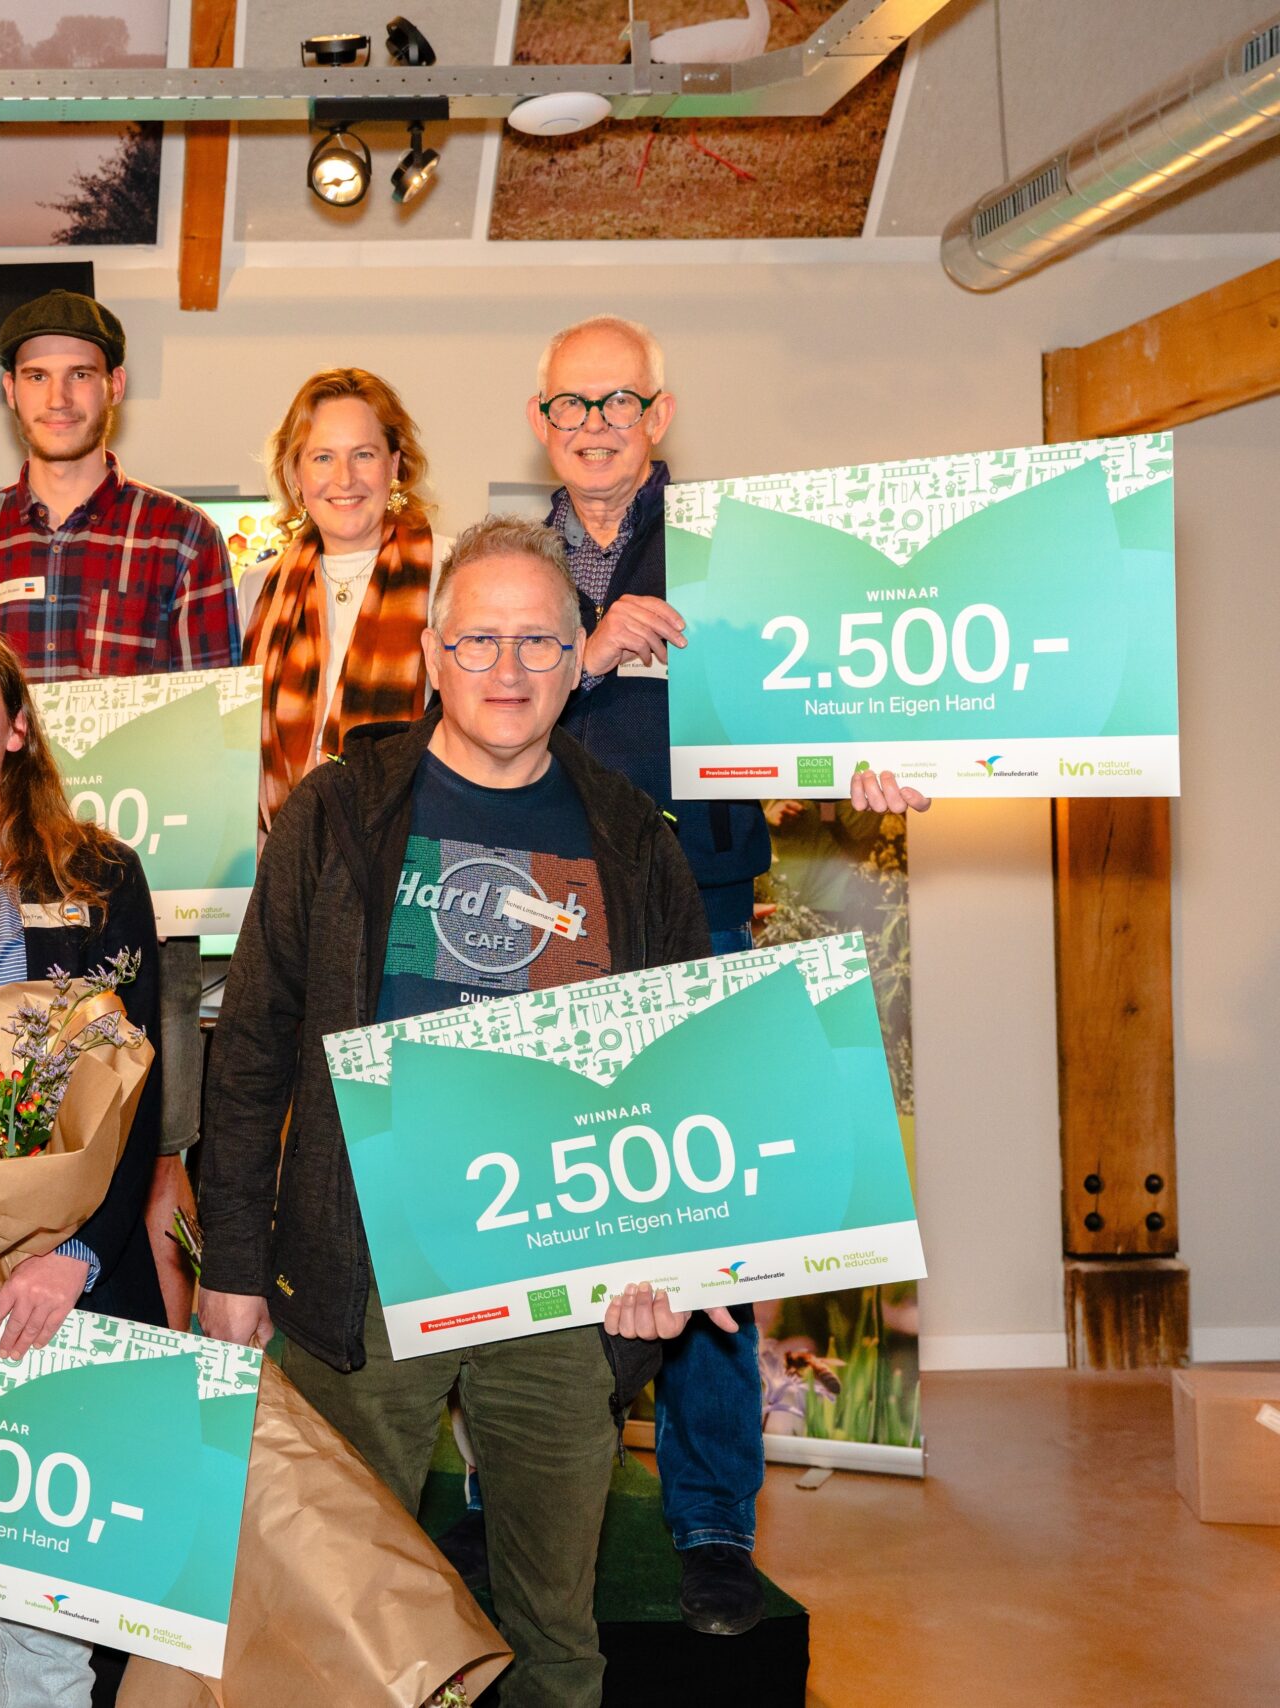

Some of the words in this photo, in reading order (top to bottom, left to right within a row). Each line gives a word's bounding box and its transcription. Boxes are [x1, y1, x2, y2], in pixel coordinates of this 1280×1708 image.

[866, 586, 939, 602] WINNAAR
[760, 603, 1069, 692] 2.500,-
[805, 699, 864, 716] Natuur
[868, 697, 885, 714] In
[889, 695, 940, 717] Eigen
[945, 692, 996, 712] Hand
[798, 758, 832, 767] GROEN
[1059, 758, 1095, 776] ivn
[901, 771, 938, 781] Landschap
[993, 770, 1039, 778] milieufederatie
[1097, 767, 1143, 776] educatie
[395, 871, 491, 917] Hard
[175, 905, 199, 920] ivn
[200, 911, 231, 919] educatie
[465, 931, 516, 952] CAFE
[573, 1102, 652, 1126] WINNAAR
[466, 1113, 796, 1232] 2.500,-
[526, 1225, 591, 1250] Natuur
[595, 1220, 614, 1237] In
[618, 1212, 672, 1234] Eigen
[676, 1201, 730, 1225] Hand
[843, 1250, 876, 1261] natuur
[844, 1256, 889, 1269] educatie
[803, 1256, 841, 1274] ivn
[701, 1278, 732, 1289] brabantse
[739, 1271, 786, 1283] milieufederatie
[529, 1287, 566, 1303] GROEN
[428, 1319, 456, 1330] Provincie
[456, 1310, 503, 1325] Noord-Brabant
[22, 1527, 70, 1553] Hand
[58, 1609, 100, 1625] milieufederatie
[118, 1614, 151, 1638] ivn
[153, 1627, 183, 1640] natuur
[152, 1634, 193, 1650] educatie
